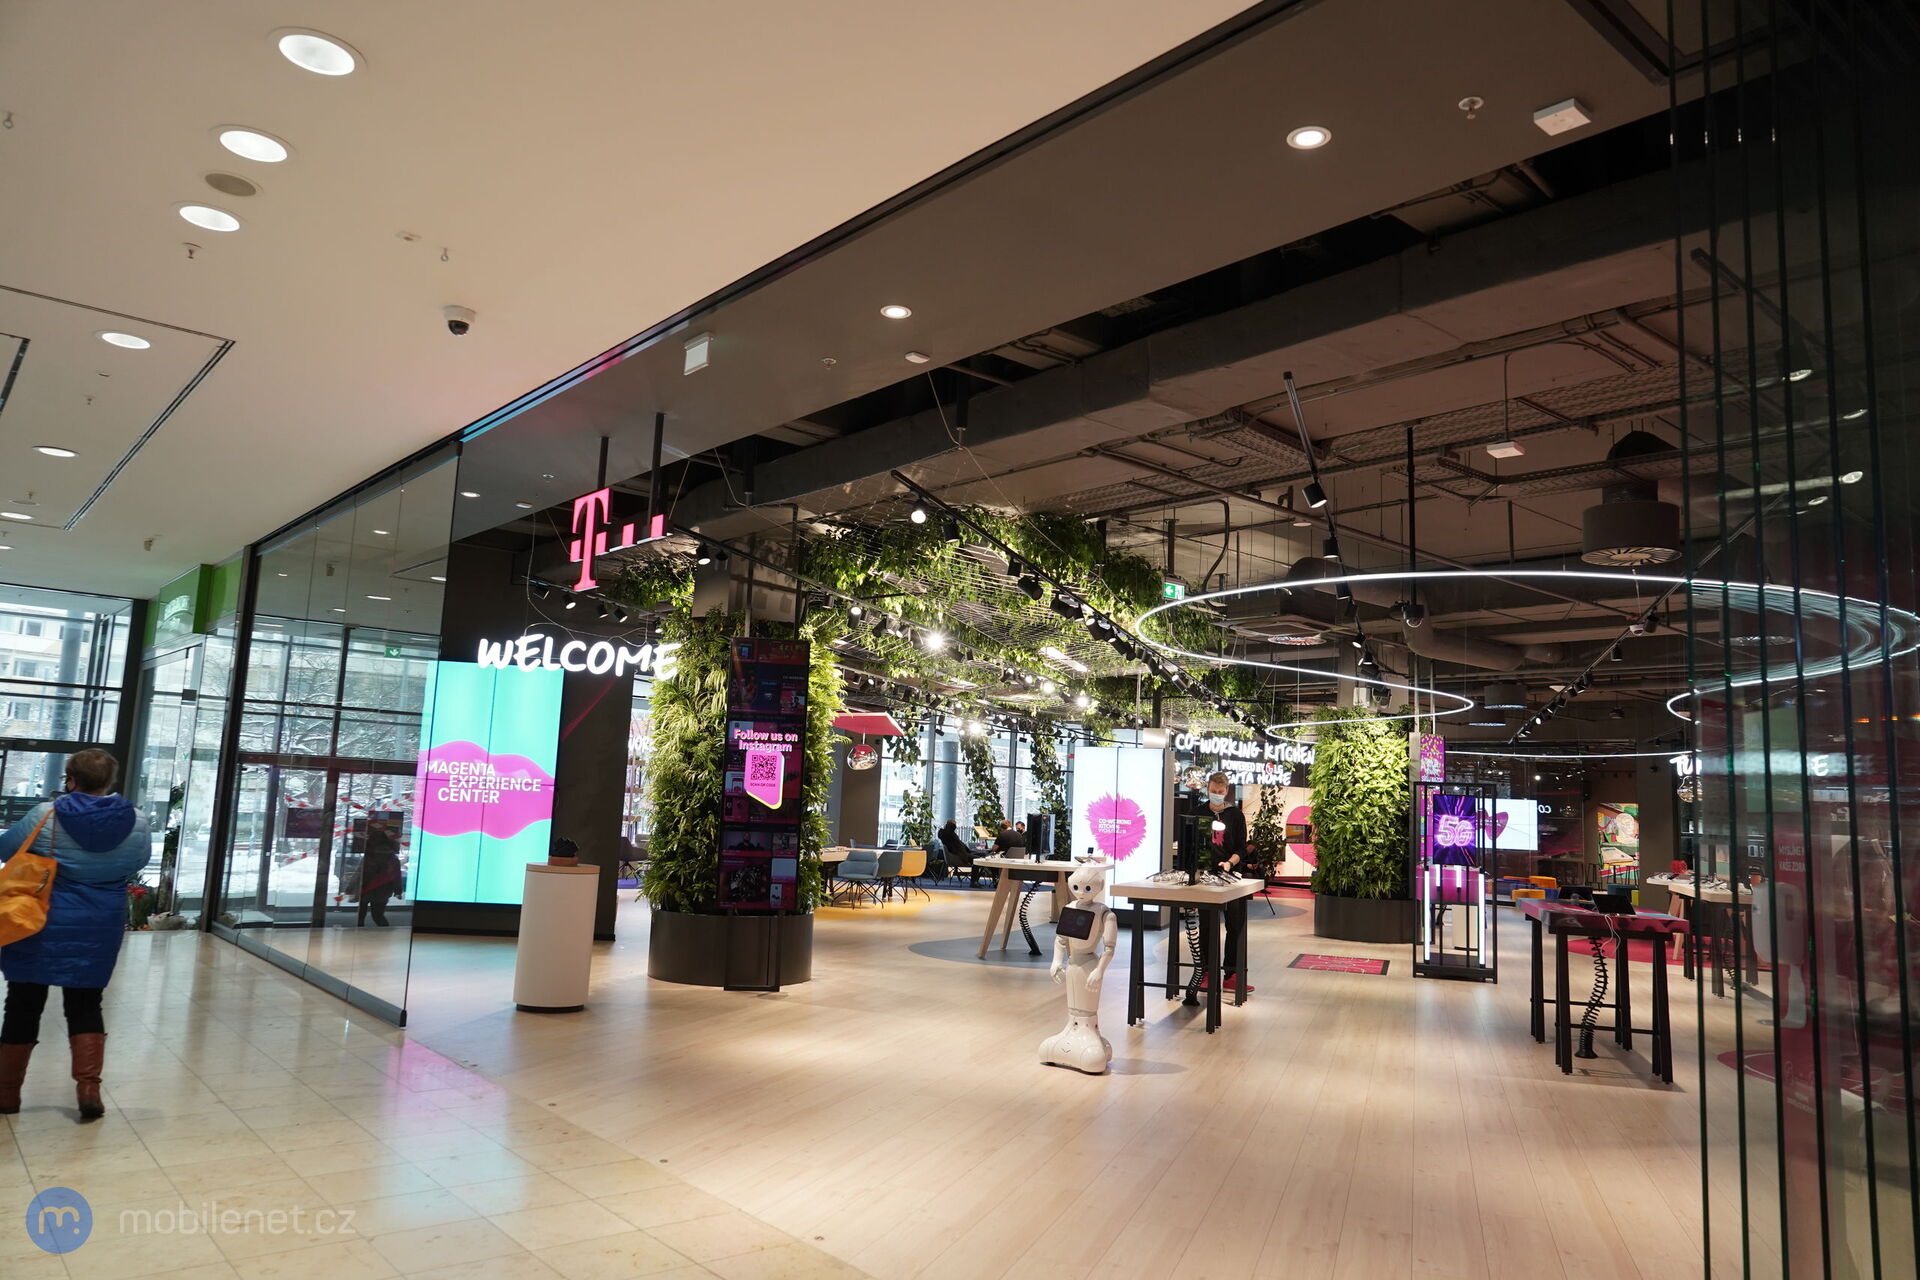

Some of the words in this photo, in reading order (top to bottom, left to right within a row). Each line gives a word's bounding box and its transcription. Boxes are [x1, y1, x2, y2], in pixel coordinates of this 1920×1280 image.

[477, 634, 681, 680] WELCOME
[734, 729, 769, 740] Follow
[771, 732, 783, 741] us
[784, 733, 798, 742] on
[739, 740, 792, 752] Instagram
[1175, 733, 1262, 758] CO-WORKING
[1264, 743, 1316, 765] KITCHEN
[425, 760, 496, 776] MAGENTA
[1221, 760, 1255, 772] POWERED
[1256, 762, 1265, 772] BY
[1274, 764, 1283, 774] LG
[449, 775, 541, 792] EXPERIENCE
[1257, 772, 1292, 786] HOME
[438, 788, 500, 804] CENTER
[1437, 814, 1473, 847] 5G
